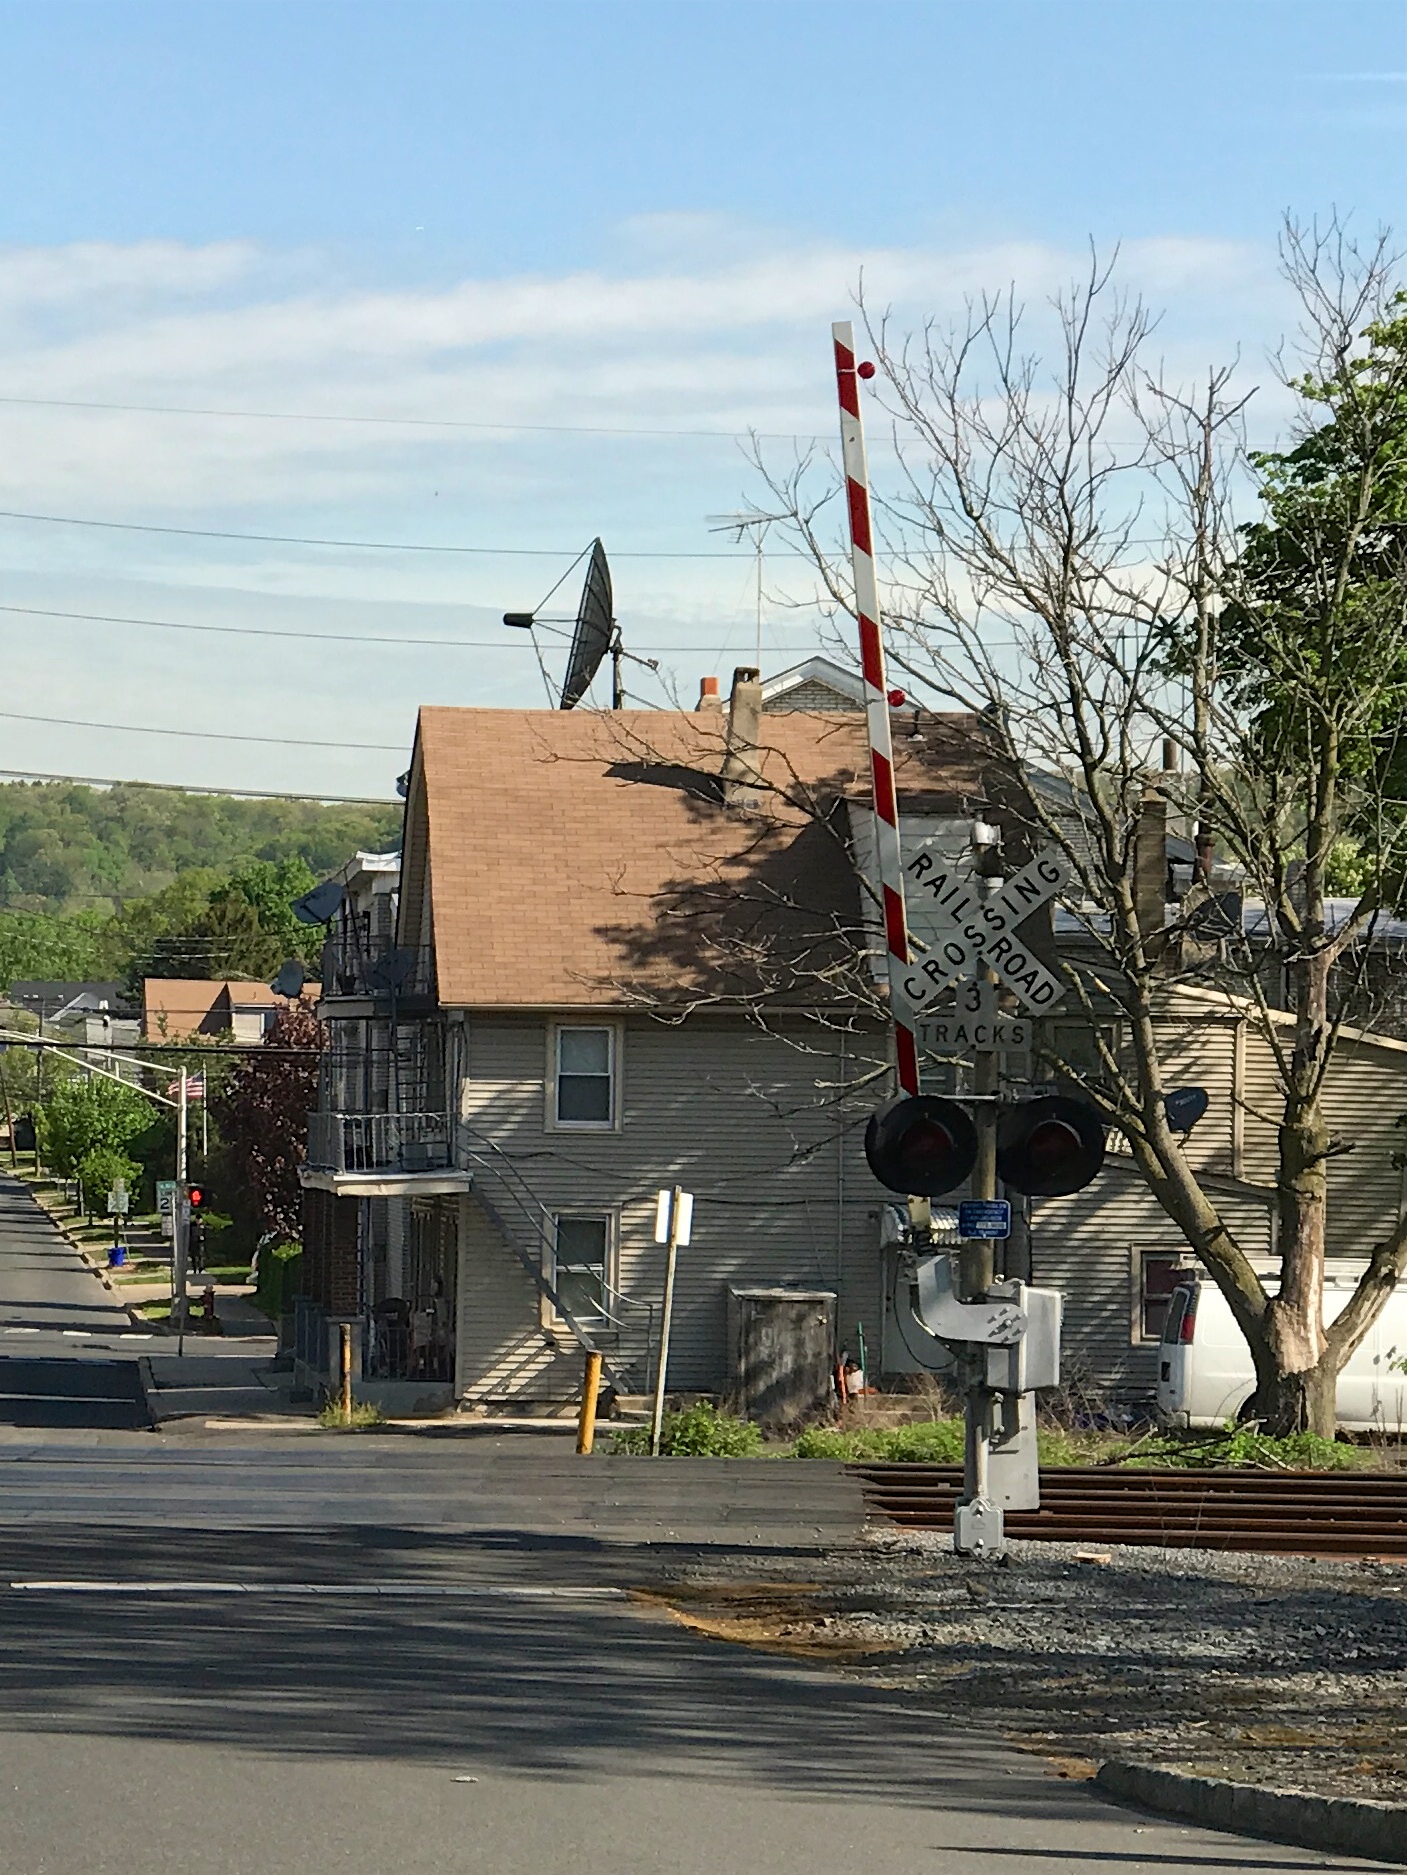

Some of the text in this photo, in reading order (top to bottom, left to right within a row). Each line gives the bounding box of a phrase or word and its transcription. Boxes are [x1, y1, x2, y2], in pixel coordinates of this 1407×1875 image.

[903, 860, 1061, 1001] CROSSING
[907, 852, 1055, 1005] RAIL ROAD
[919, 1023, 1025, 1044] TRACKS
[964, 987, 981, 1012] 3
